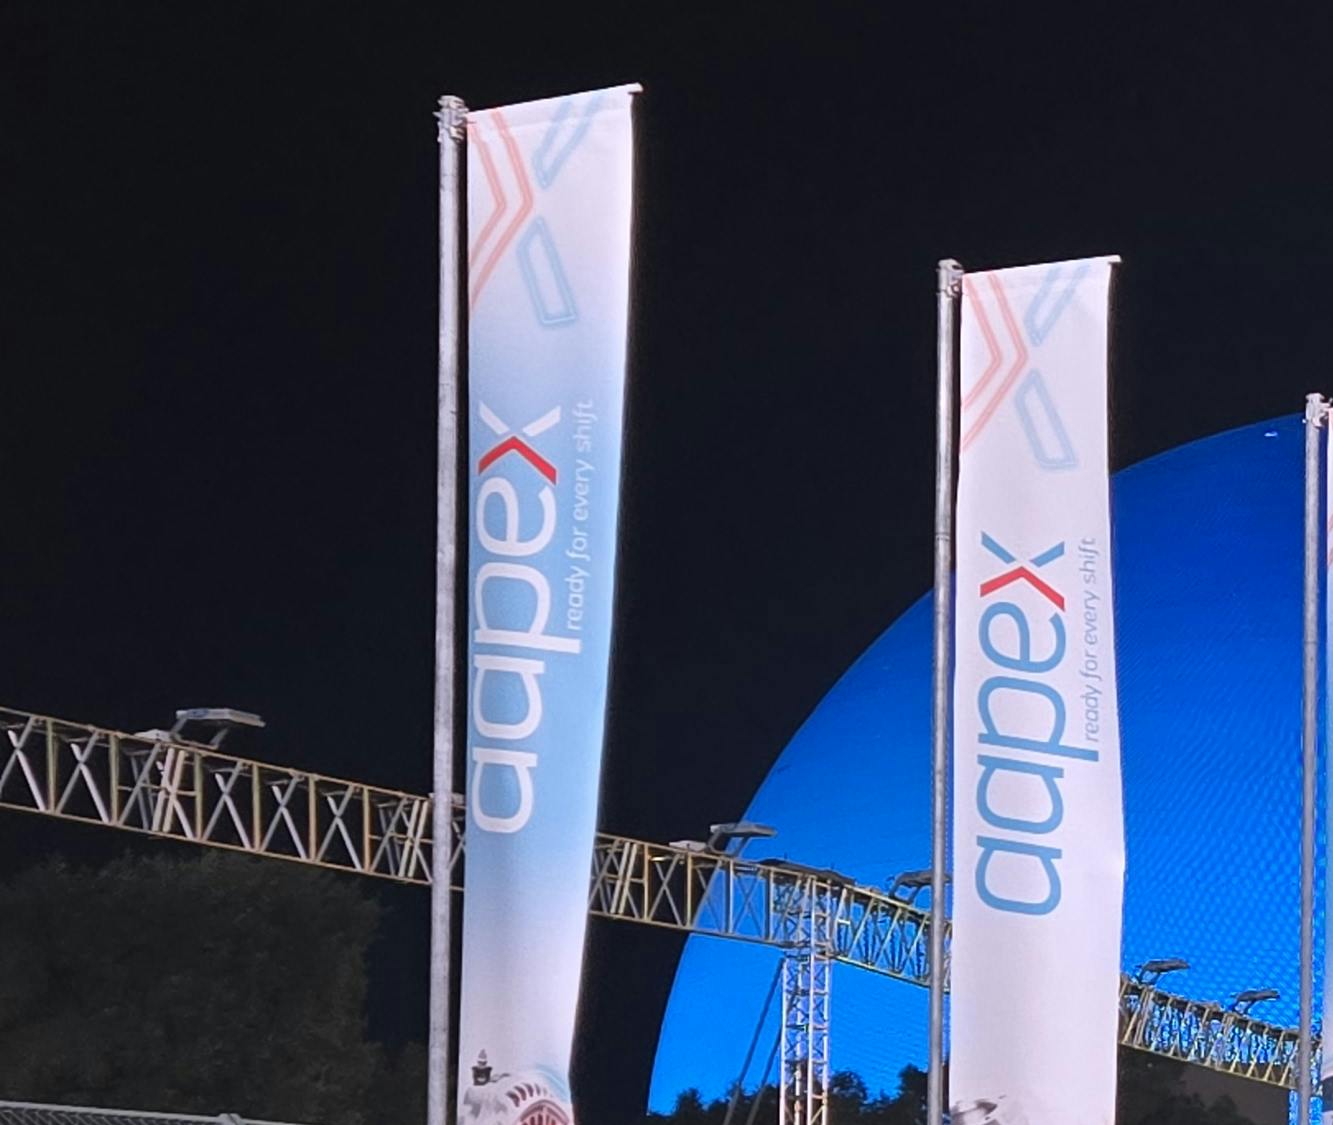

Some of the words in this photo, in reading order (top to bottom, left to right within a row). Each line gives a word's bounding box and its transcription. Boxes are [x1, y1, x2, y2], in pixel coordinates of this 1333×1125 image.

[571, 398, 597, 452] shift
[571, 459, 596, 521] every
[565, 526, 591, 561] for
[1078, 537, 1098, 584] shift
[471, 401, 581, 834] aapex
[565, 565, 591, 631] ready
[1082, 590, 1101, 646] every
[1079, 650, 1102, 681] for
[975, 530, 1099, 916] aapex
[1080, 684, 1102, 742] ready
